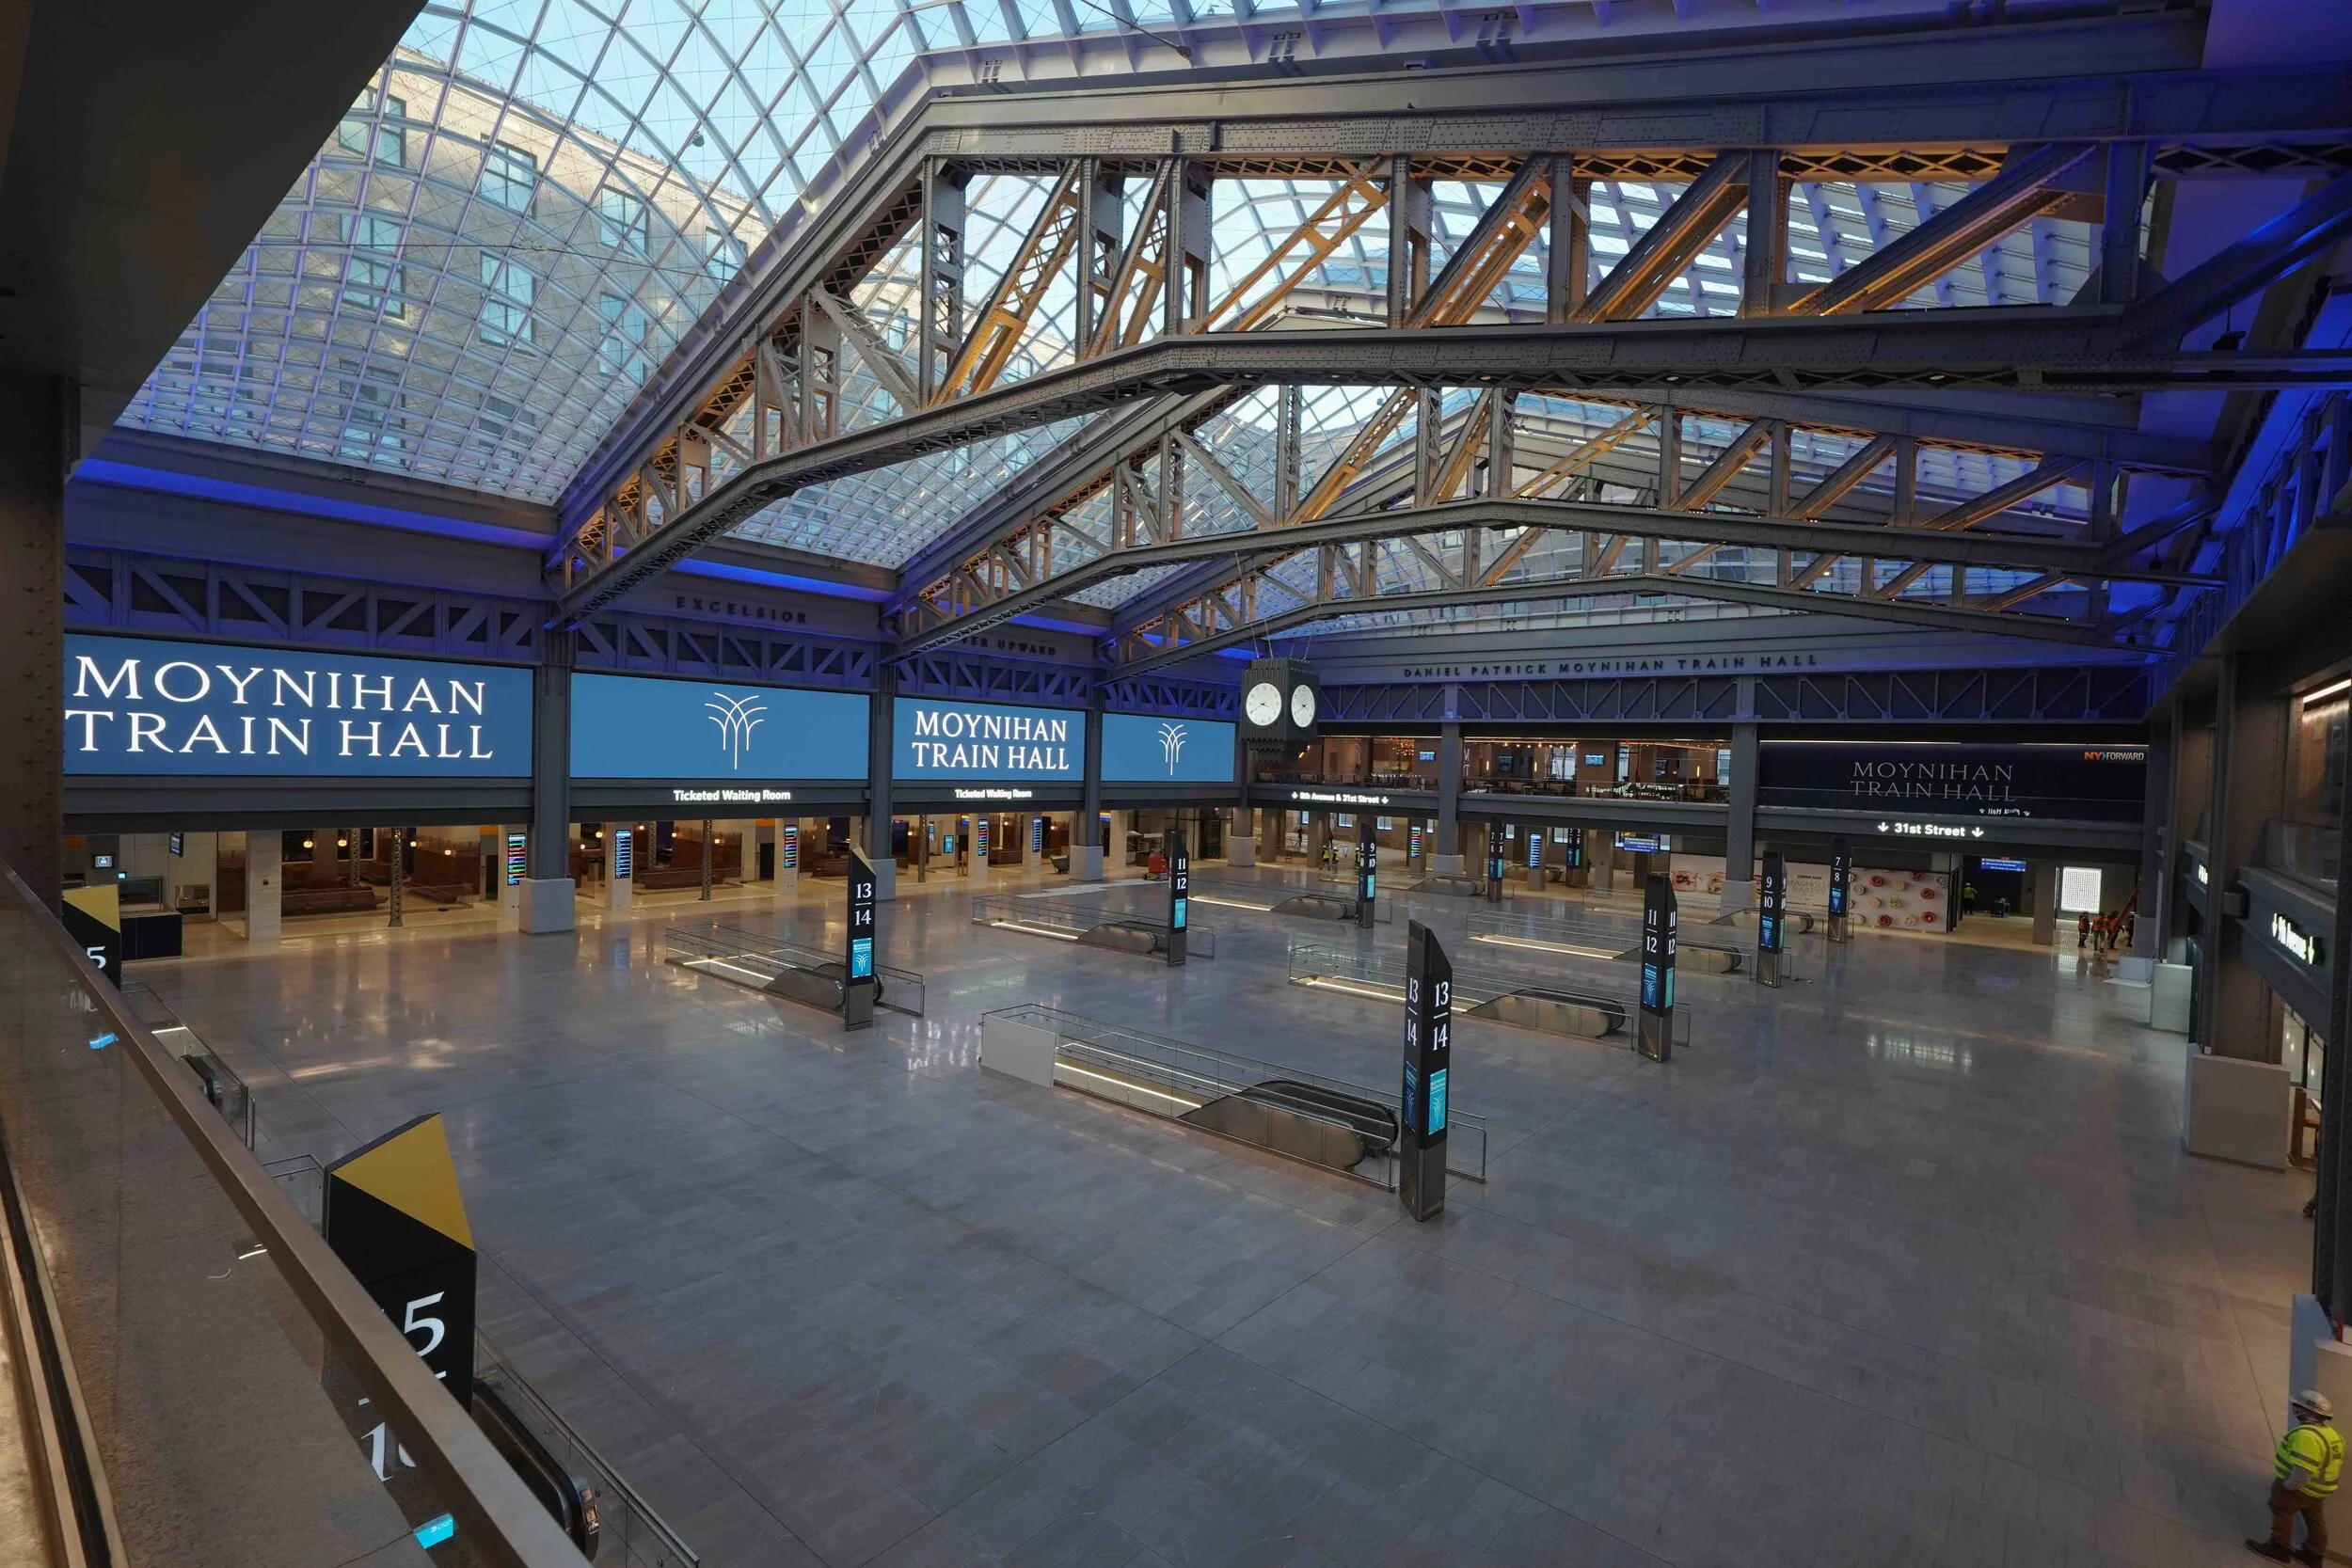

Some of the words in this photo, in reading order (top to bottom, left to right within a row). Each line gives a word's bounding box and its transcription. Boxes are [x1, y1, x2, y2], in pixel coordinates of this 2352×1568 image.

[675, 596, 806, 624] EXCELSIOR
[998, 640, 1056, 656] UPWARD
[1404, 667, 1460, 677] DANIEL
[1470, 664, 1547, 675] PATRICK
[1558, 660, 1663, 673] MOYNIHAN
[1677, 657, 1744, 670] TRAIN
[1760, 654, 1817, 667] HALL
[72, 656, 485, 716] MOYNIHAN
[65, 709, 311, 755] TRAIN
[339, 720, 493, 759] HALL
[914, 710, 1067, 742] MOYNIHAN
[912, 742, 999, 768] TRAIN
[1008, 746, 1070, 769] HALL
[2106, 752, 2145, 761] FORWARD
[1853, 761, 2013, 782] MOYNIHAN
[674, 790, 720, 800] Ticketed
[722, 790, 761, 802] Waiting
[763, 789, 791, 800] Room
[955, 789, 986, 799] Ticketed
[987, 789, 1012, 800] Waiting
[1013, 789, 1032, 799] Room
[1343, 794, 1357, 802] 31st
[1358, 795, 1379, 803] Street
[1850, 781, 1932, 799] TRAIN
[1944, 784, 2017, 802] HALL
[1895, 823, 1922, 834] 31st
[1925, 824, 1966, 837] Street
[1370, 843, 1375, 851] 9
[1178, 858, 1186, 870] 11
[1836, 856, 1841, 865] 7
[1176, 878, 1186, 890] 12
[1766, 876, 1772, 888] 9
[1834, 872, 1840, 881] 8
[855, 882, 872, 899] 13
[1764, 896, 1773, 909] 10
[855, 909, 872, 926] 14
[1648, 909, 1657, 926] 11
[1670, 911, 1676, 927] 11
[1646, 936, 1658, 953] 12
[1668, 938, 1676, 955] 12
[1408, 977, 1419, 1004] 13
[1435, 981, 1449, 1007] 13
[1406, 1019, 1418, 1047] 14
[1432, 1023, 1448, 1052] 14
